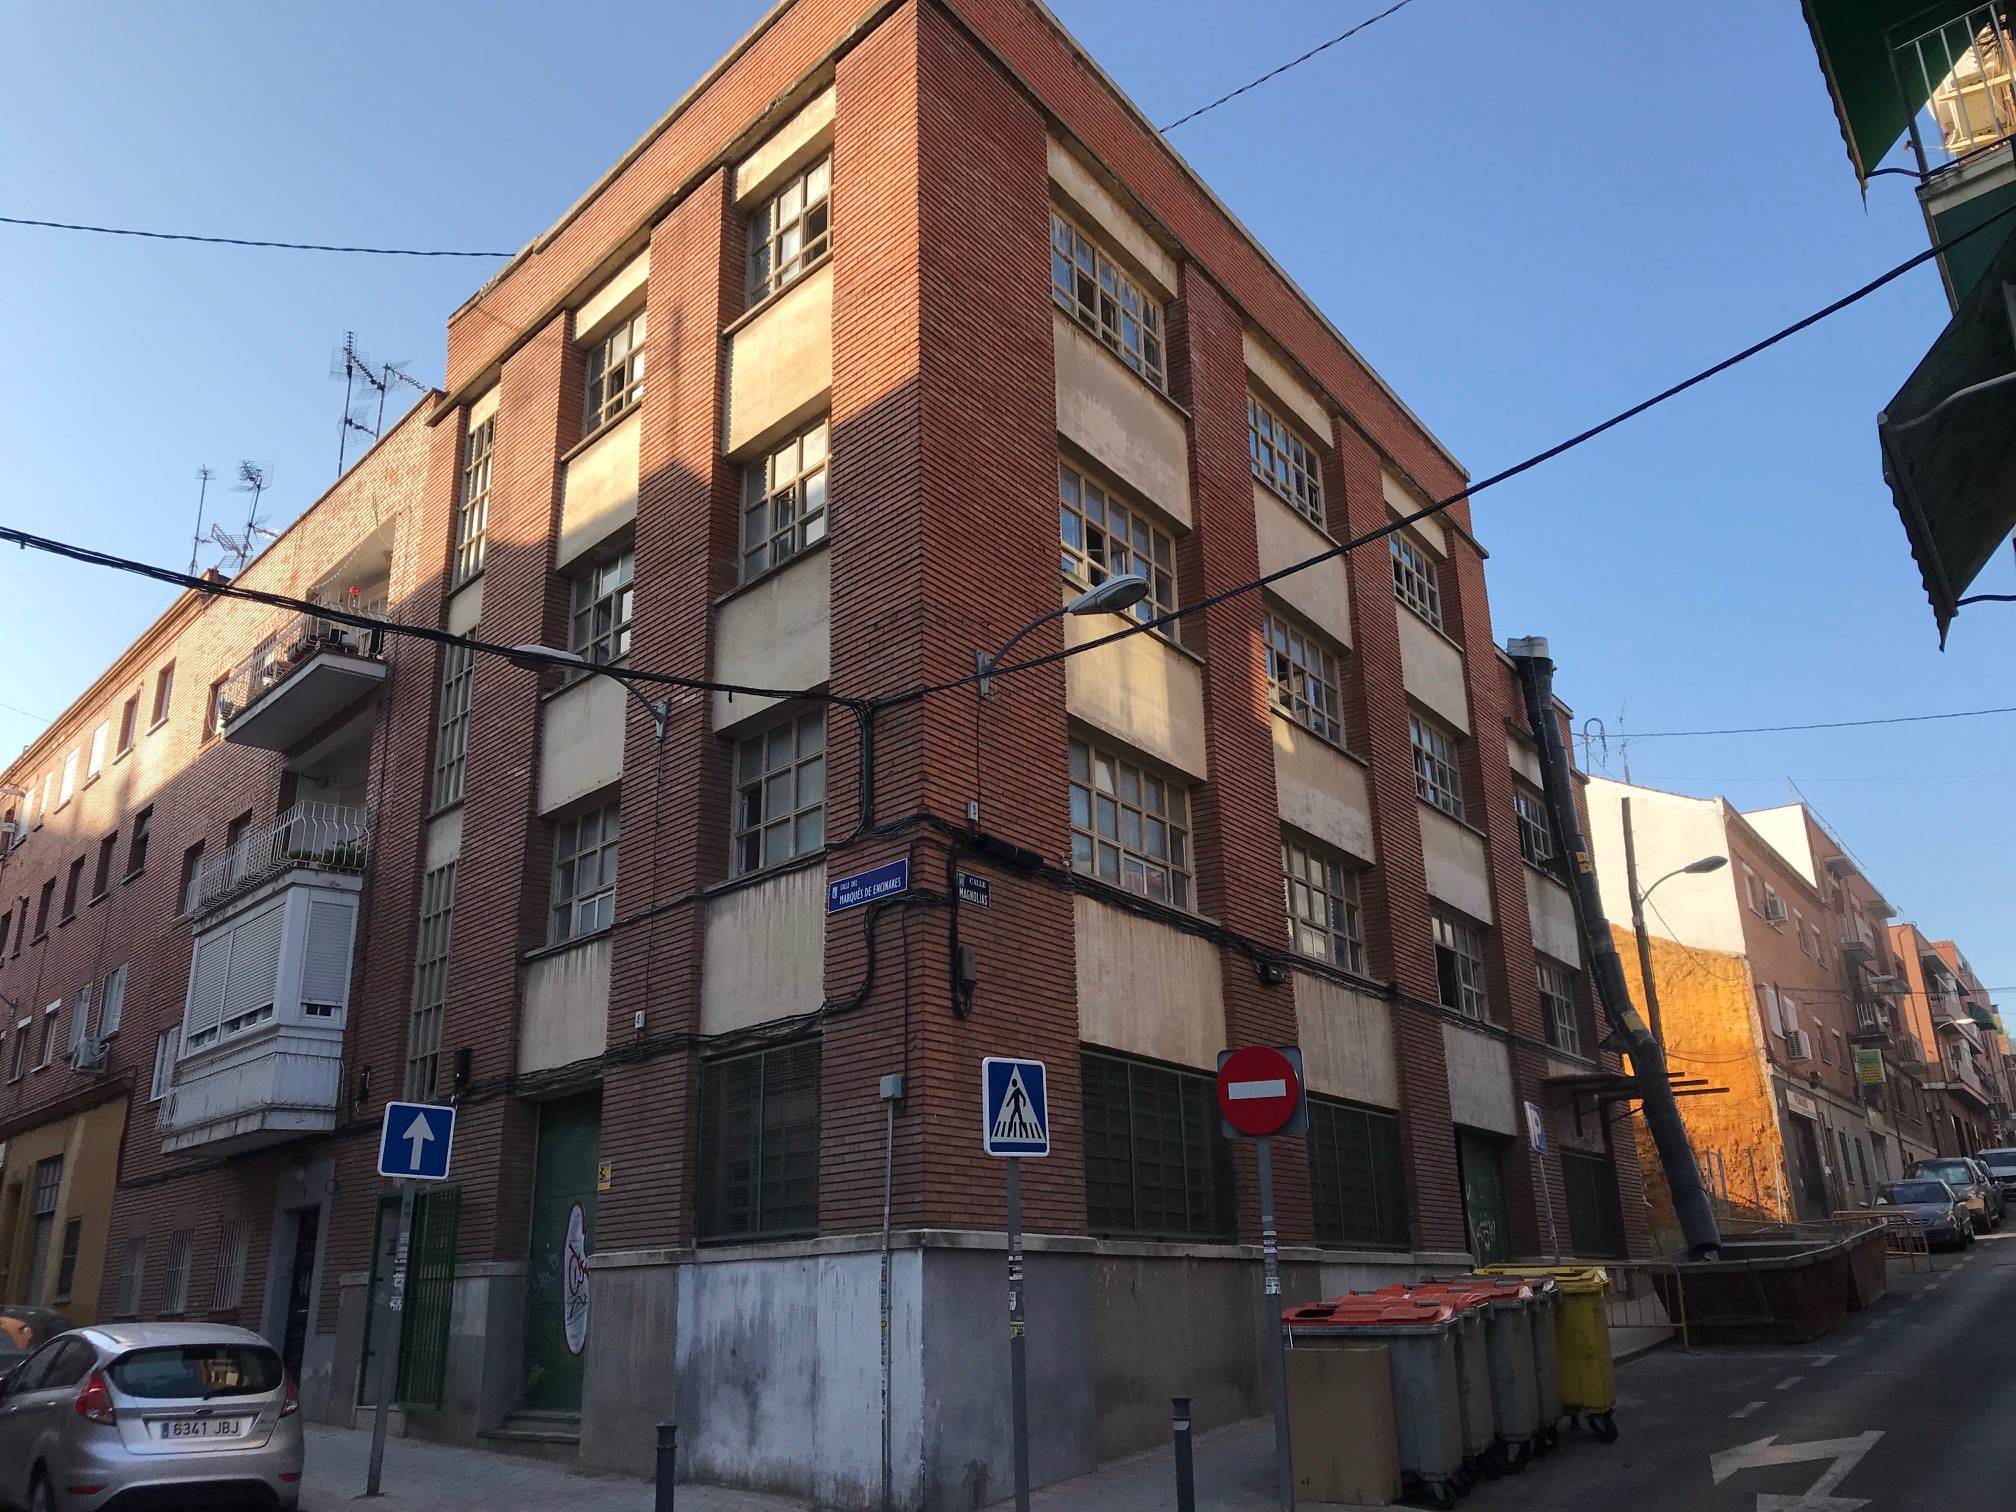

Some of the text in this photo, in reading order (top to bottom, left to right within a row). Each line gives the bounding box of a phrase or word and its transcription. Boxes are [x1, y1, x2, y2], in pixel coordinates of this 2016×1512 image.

[839, 876, 901, 905] MARQUÉS DE ENCINARES
[840, 881, 850, 891] CALLE
[970, 877, 986, 889] CALLE
[959, 887, 988, 906] MAGNOLIAS
[173, 1421, 239, 1436] 6341 JBJ
